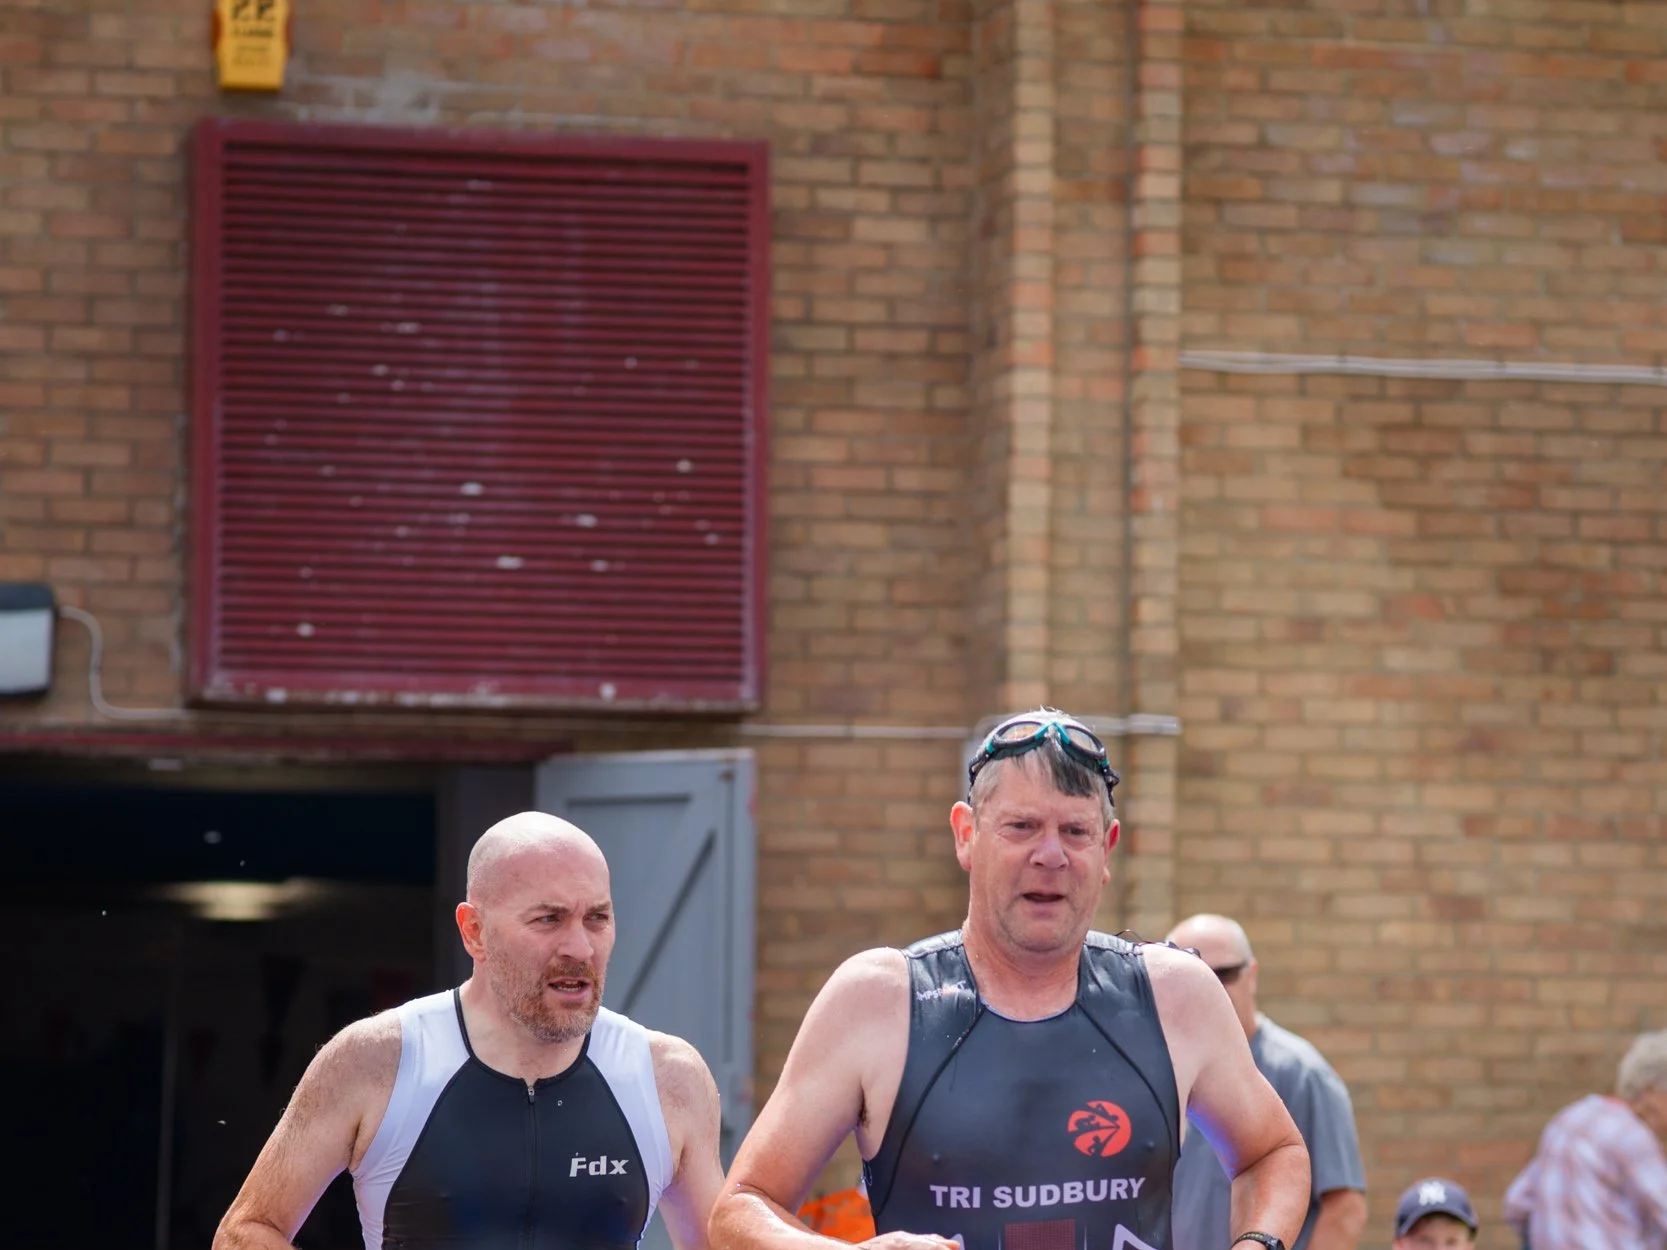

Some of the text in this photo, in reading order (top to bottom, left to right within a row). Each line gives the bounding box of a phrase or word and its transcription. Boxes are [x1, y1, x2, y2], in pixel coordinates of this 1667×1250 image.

[568, 1155, 630, 1178] Fdx
[929, 1177, 1146, 1209] TRI SUDBURY
